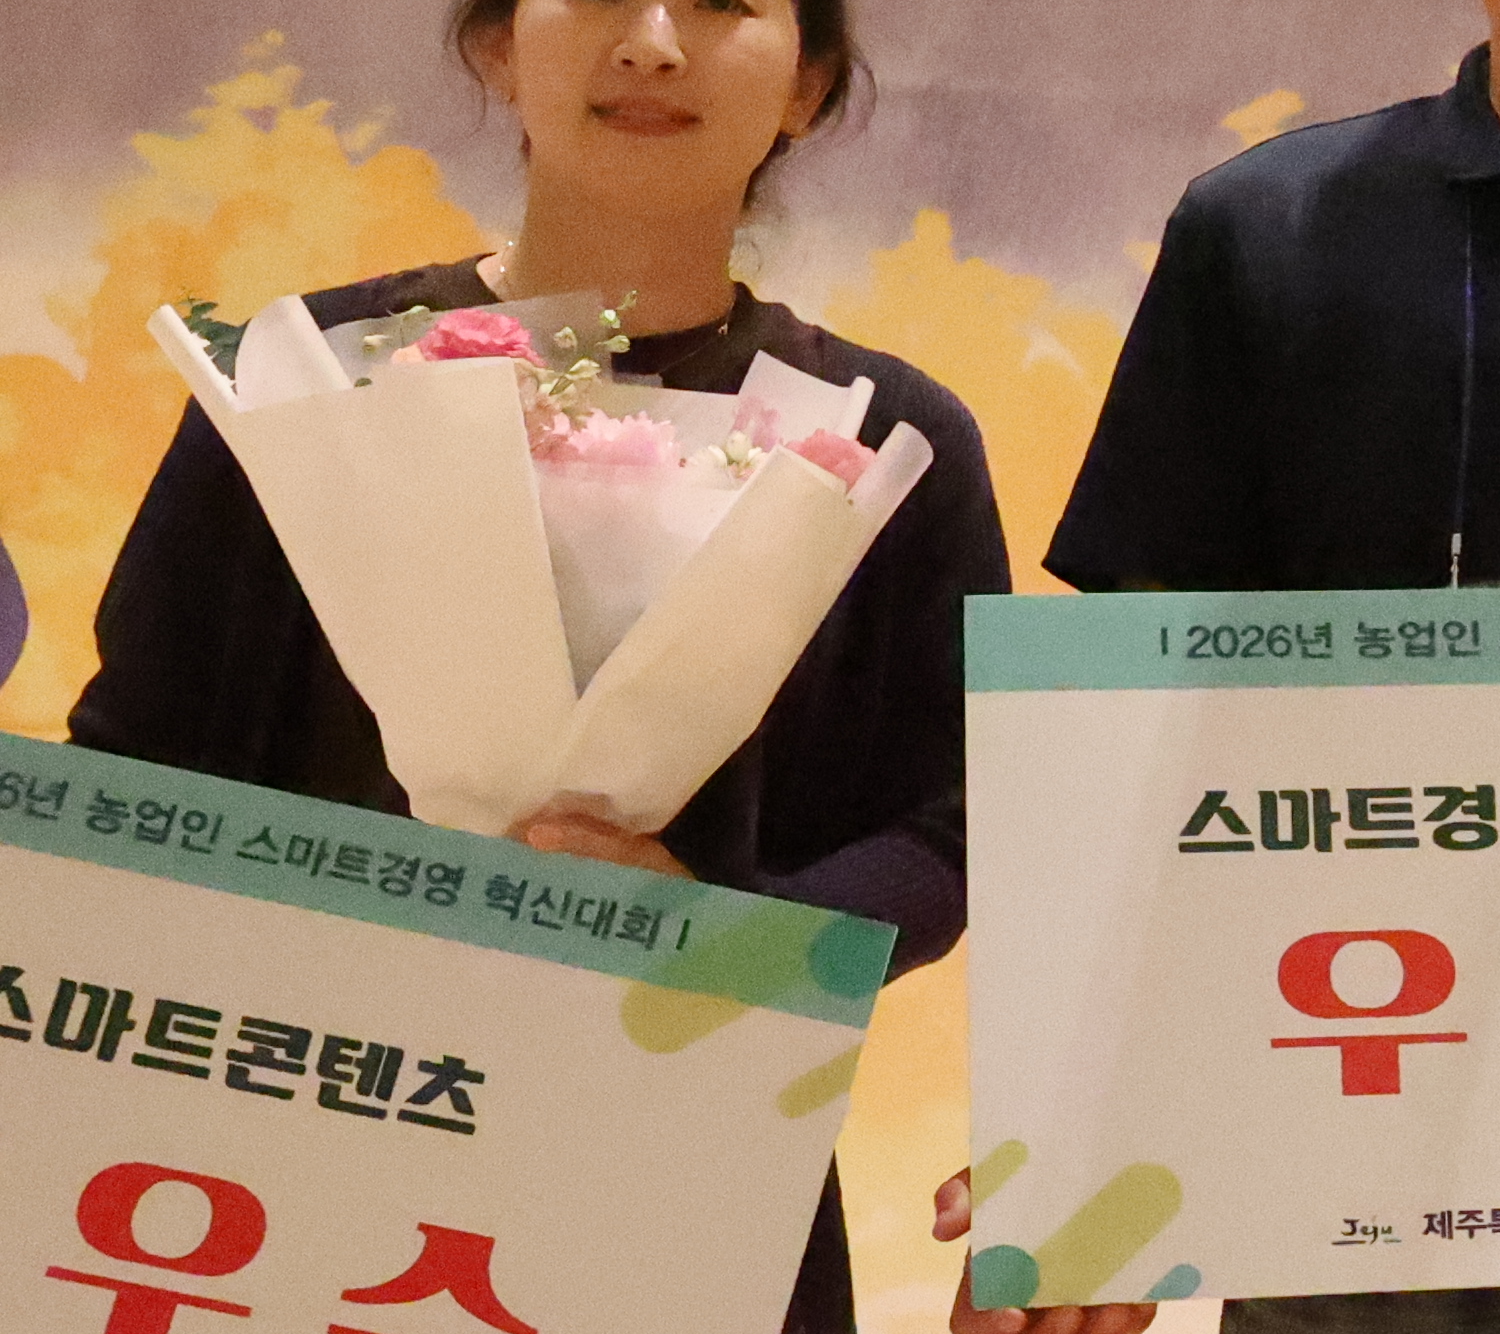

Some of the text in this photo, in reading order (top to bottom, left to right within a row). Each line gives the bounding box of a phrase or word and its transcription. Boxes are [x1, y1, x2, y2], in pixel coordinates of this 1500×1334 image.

[1185, 620, 1334, 661] 2026년
[1353, 619, 1481, 661] 농업인
[84, 787, 225, 856] 농업인
[233, 824, 467, 908] 스마트경영
[483, 873, 664, 952] 혁신대회
